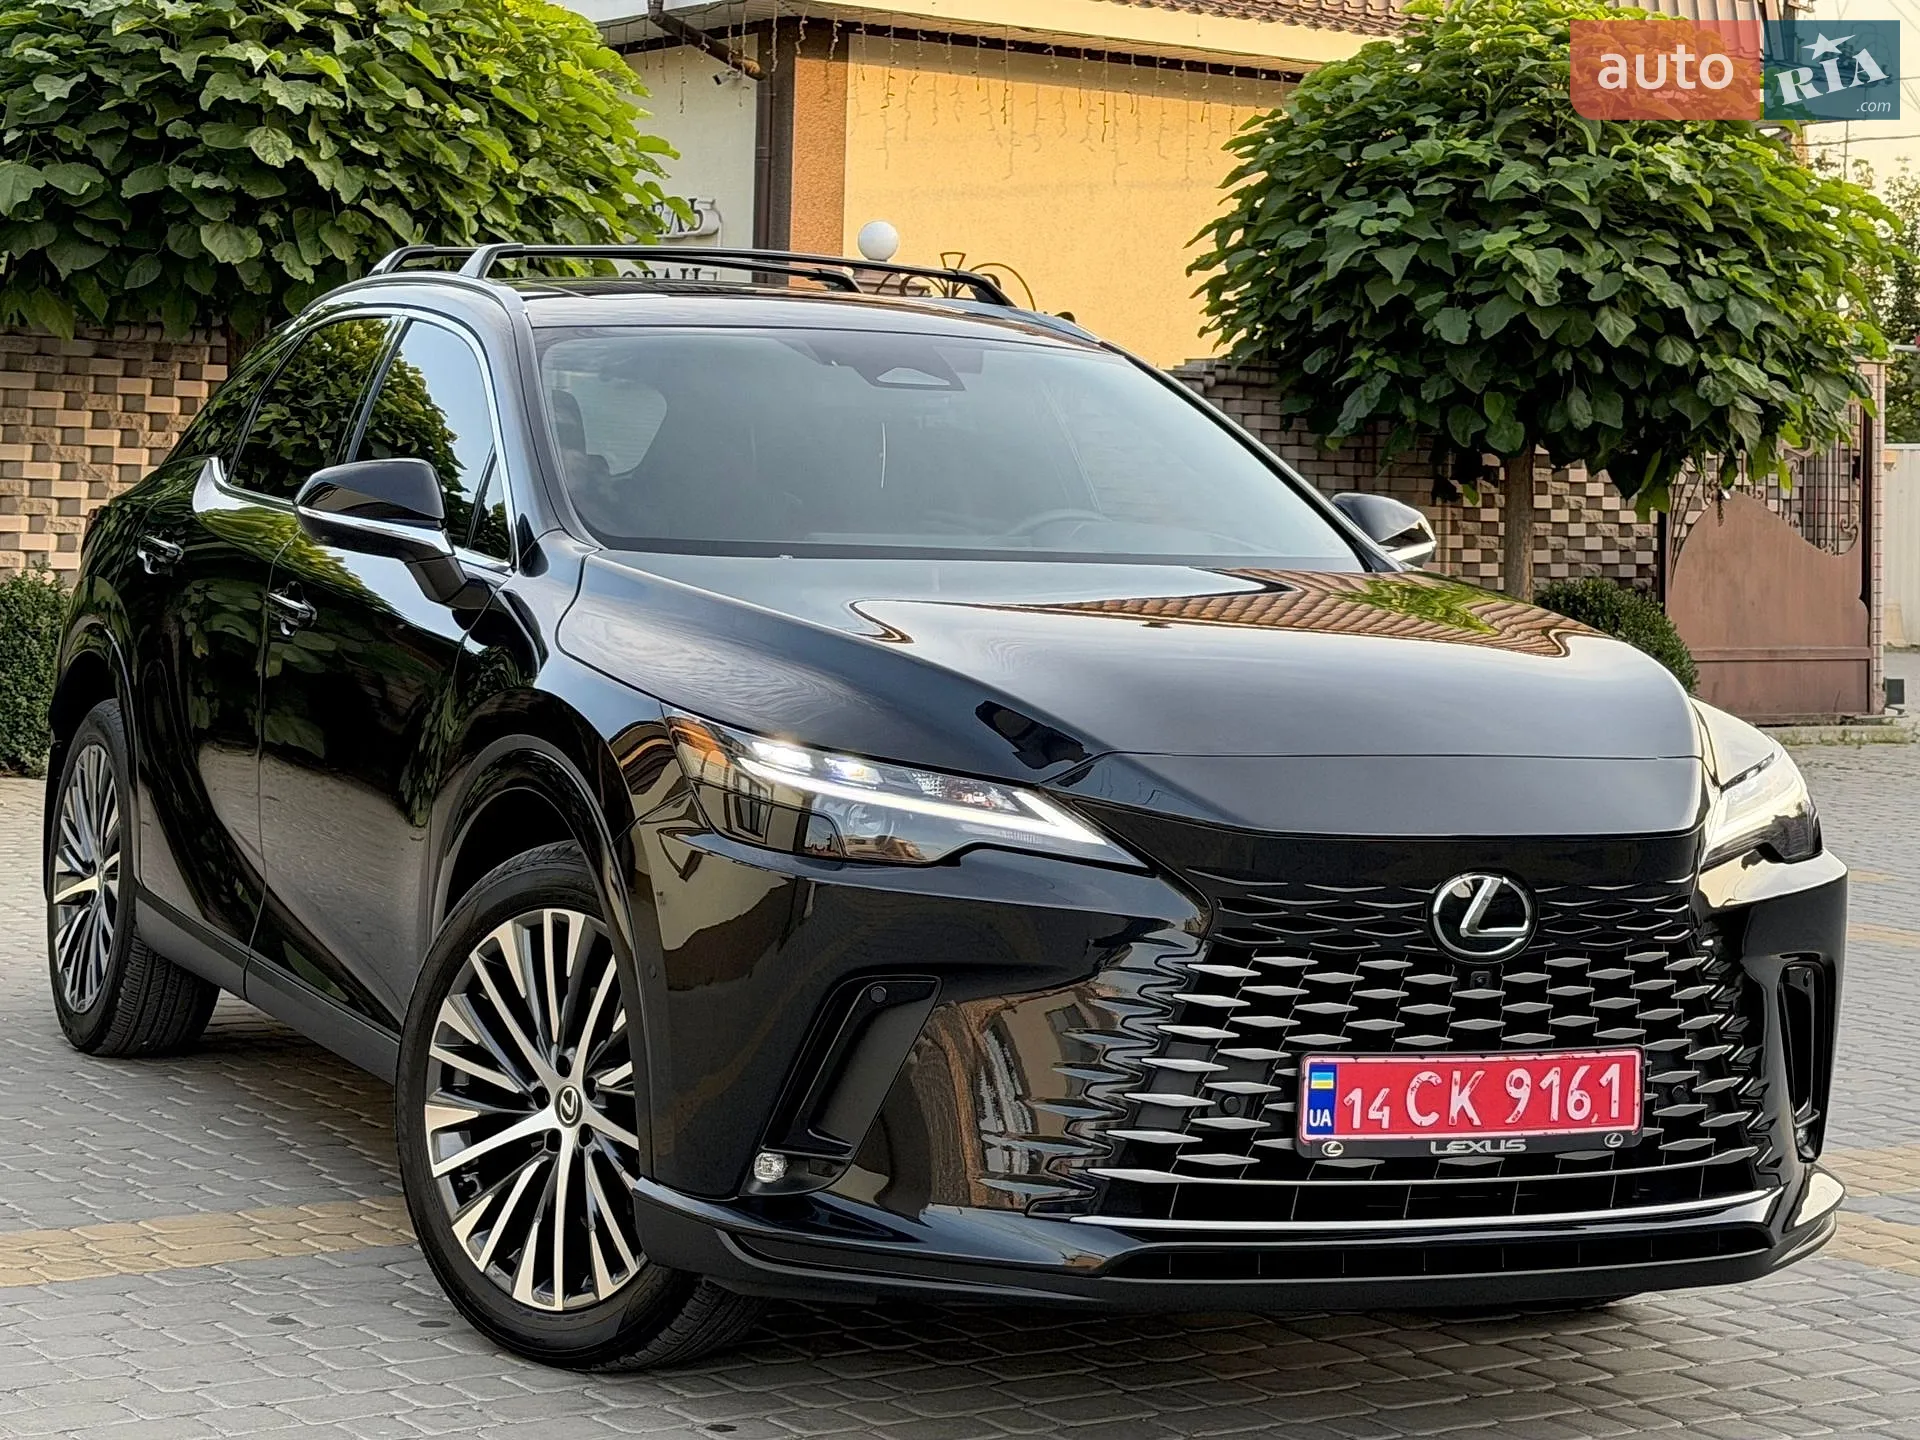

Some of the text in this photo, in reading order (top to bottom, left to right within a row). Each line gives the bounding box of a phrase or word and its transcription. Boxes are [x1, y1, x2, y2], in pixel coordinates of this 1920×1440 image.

[1343, 1063, 1621, 1129] 14 CK 9161
[1309, 1108, 1332, 1127] UA
[1430, 1138, 1527, 1155] LEXUS
